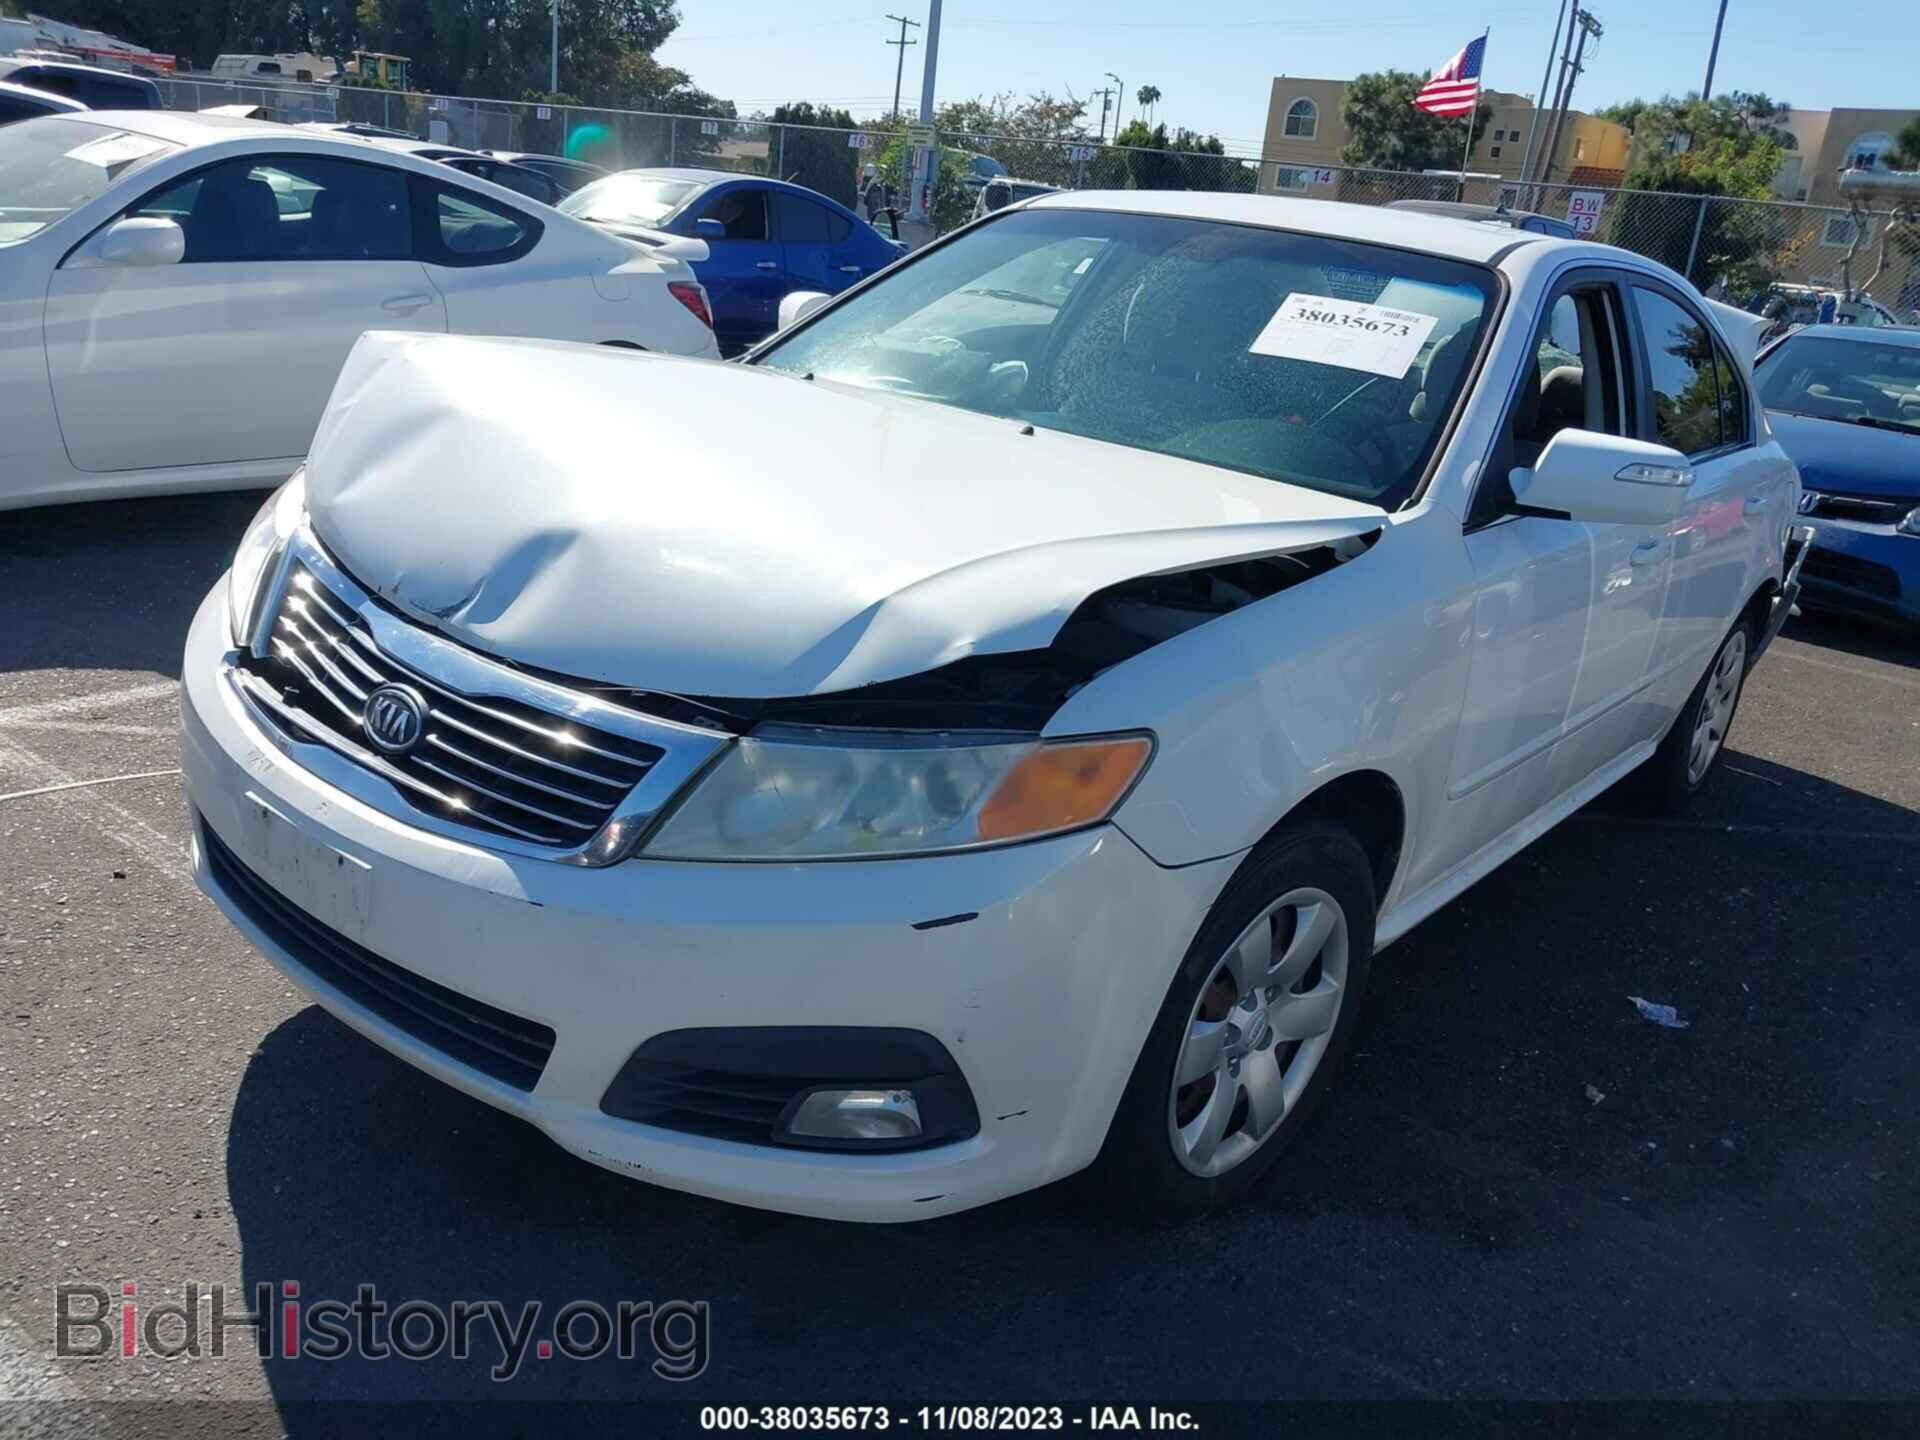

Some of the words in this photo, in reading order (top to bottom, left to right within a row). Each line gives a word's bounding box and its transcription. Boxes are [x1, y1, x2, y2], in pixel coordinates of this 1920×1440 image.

[1074, 147, 1090, 160] 15
[1314, 170, 1330, 183] 14
[1572, 215, 1593, 231] 13
[1290, 308, 1410, 336] 38035673
[371, 696, 410, 742] KIA
